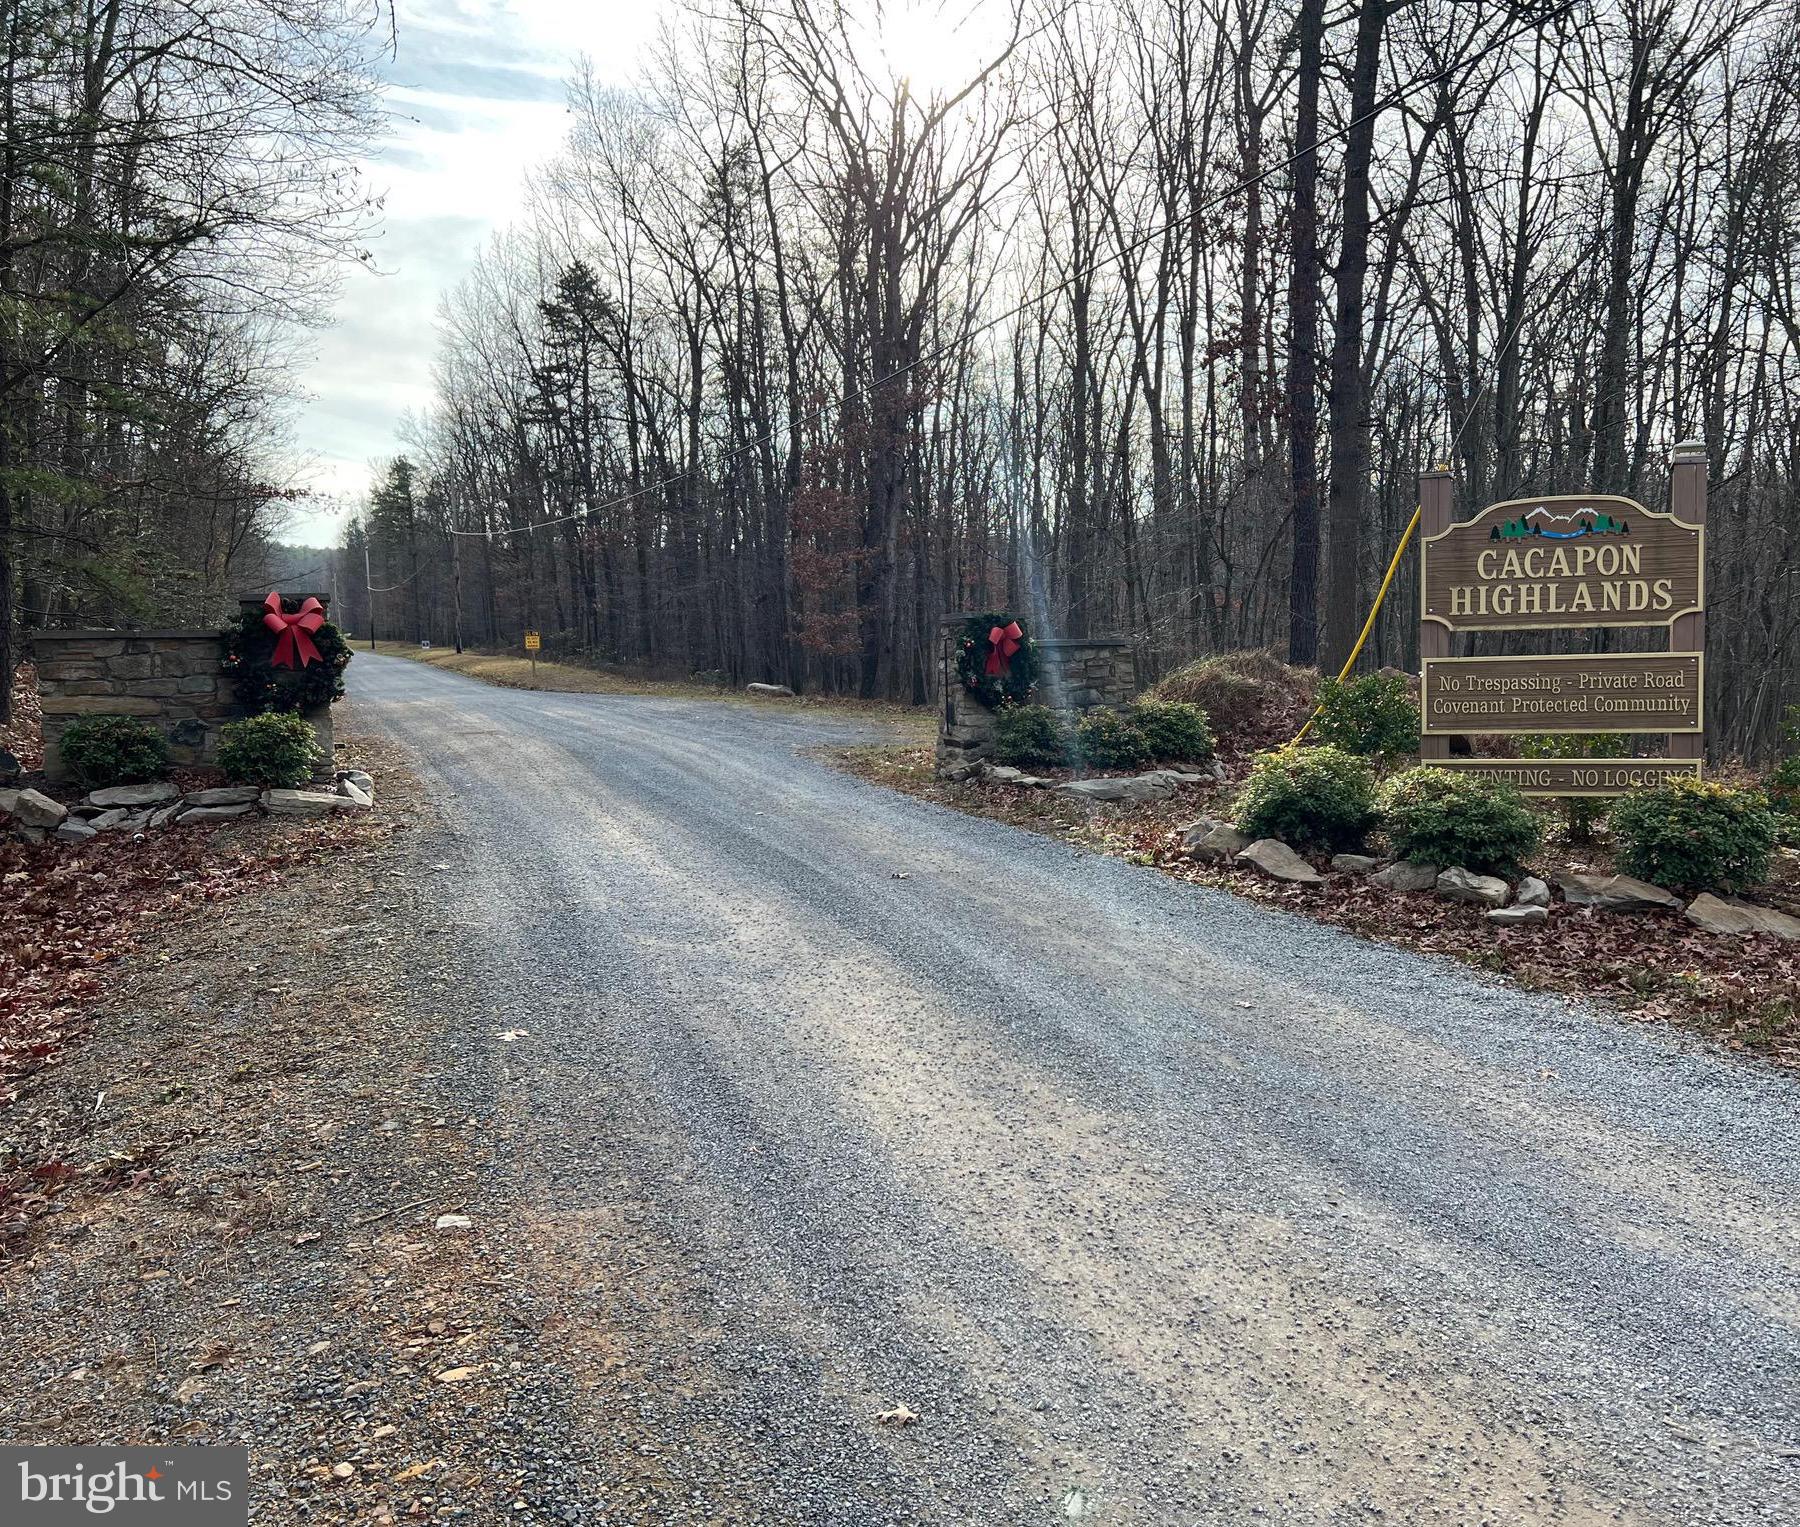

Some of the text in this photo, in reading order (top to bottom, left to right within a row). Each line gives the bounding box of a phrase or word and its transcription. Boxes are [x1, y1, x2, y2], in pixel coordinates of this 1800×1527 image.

[1477, 544, 1643, 580] CACAPON
[1449, 578, 1673, 616] HIGHLANDS
[1439, 675, 1460, 691] No
[1466, 672, 1561, 694] Trespassing
[1579, 672, 1637, 689] Private
[1643, 669, 1685, 688] Road
[1433, 693, 1690, 715] Covenant Protected Community
[1459, 769, 1552, 787] UNTING
[1571, 769, 1599, 787] NO
